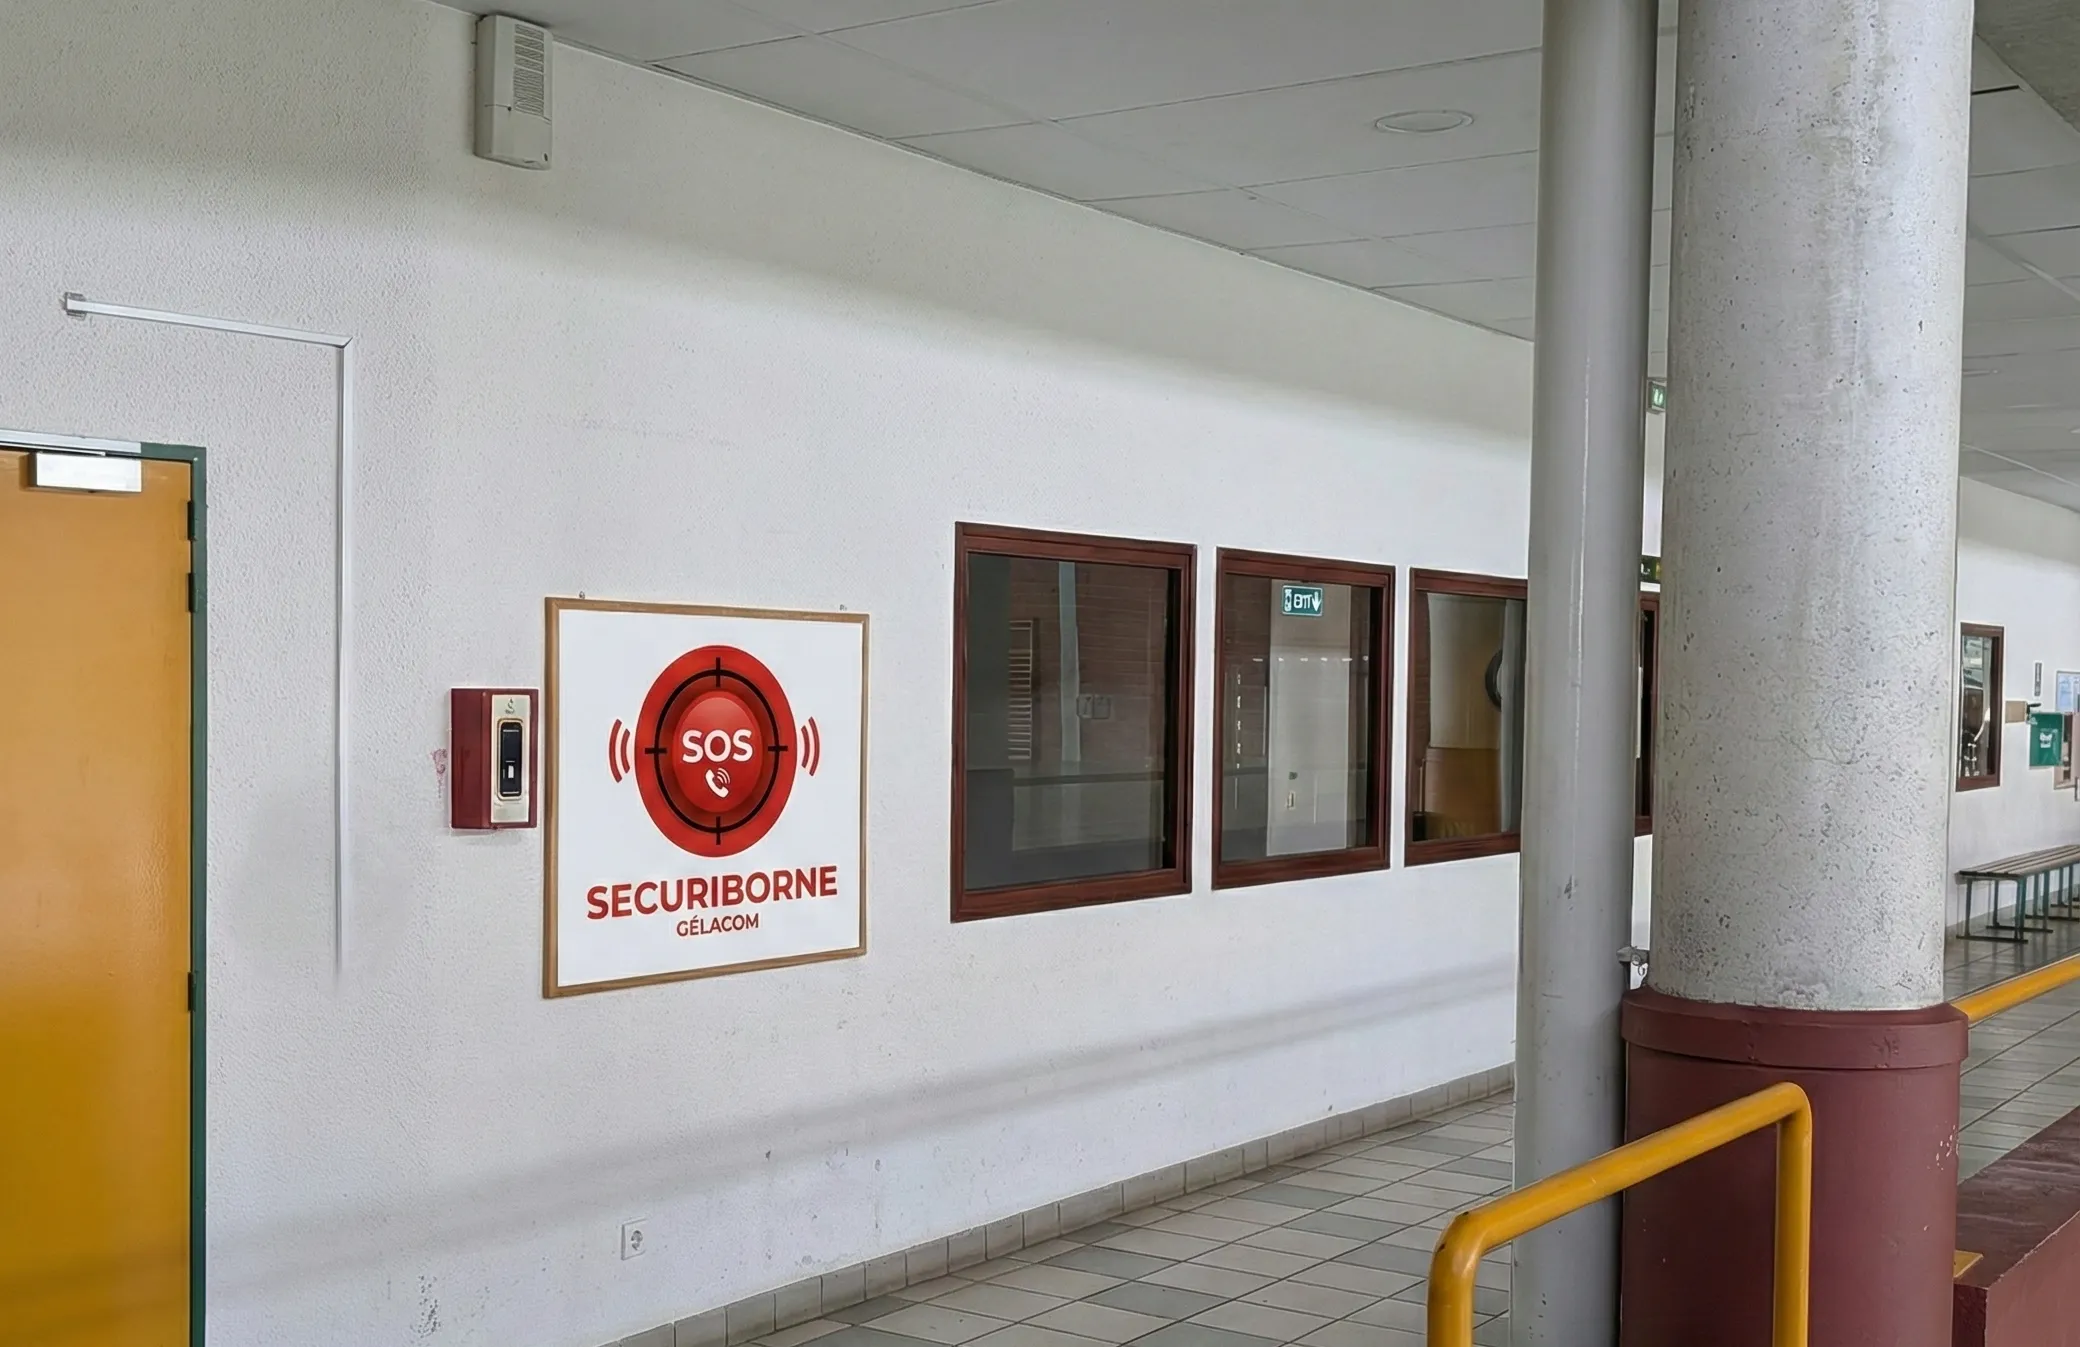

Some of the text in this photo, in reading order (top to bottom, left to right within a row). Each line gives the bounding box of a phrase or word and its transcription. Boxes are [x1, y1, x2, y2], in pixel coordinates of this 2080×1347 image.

[682, 729, 753, 763] SOS
[587, 866, 837, 920] SECURIBORNE
[676, 913, 759, 937] GÉLACOM
